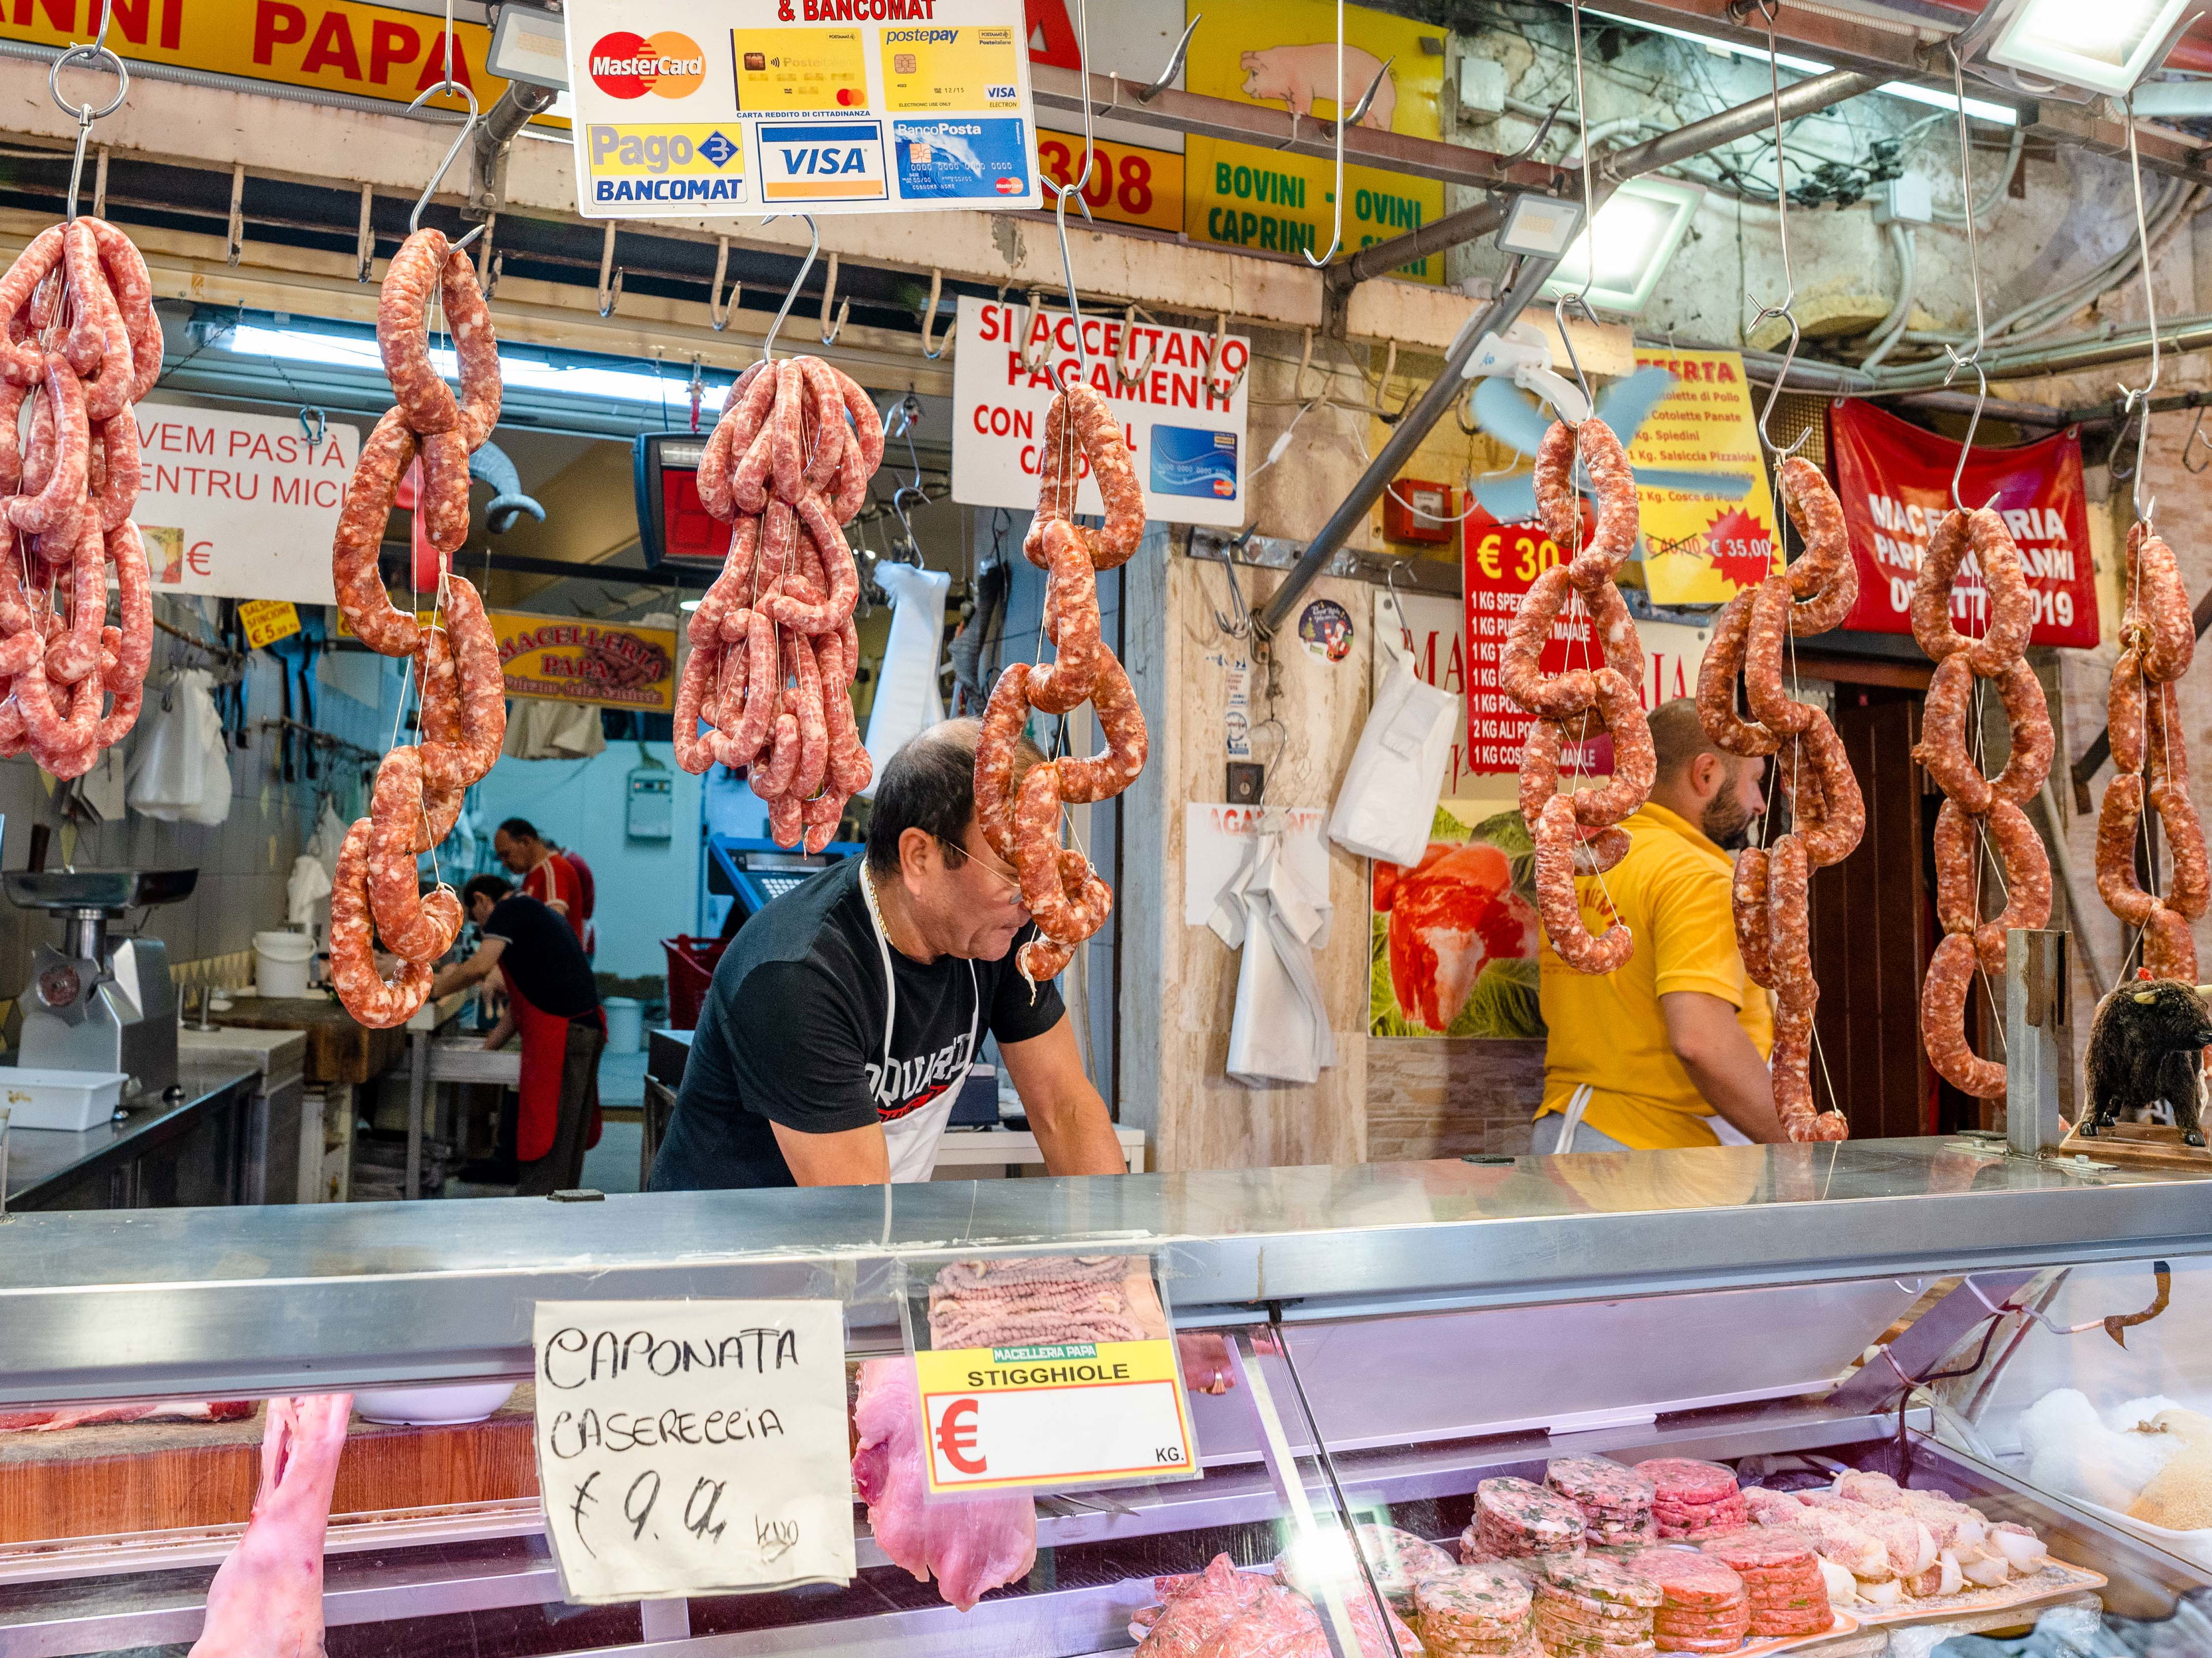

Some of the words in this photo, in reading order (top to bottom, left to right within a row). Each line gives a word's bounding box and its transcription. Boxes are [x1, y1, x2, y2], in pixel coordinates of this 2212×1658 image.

[803, 0, 936, 21] BANCOMAT
[887, 29, 959, 45] postepay
[0, 0, 180, 50] NNI
[252, 0, 476, 99] PAPA
[592, 55, 702, 76] MasterCard
[987, 87, 1016, 98] VISA
[897, 123, 982, 135] BancoPosta
[590, 126, 694, 173] Pago
[779, 147, 866, 175] VISA
[596, 179, 743, 202] BANCOMAT
[1216, 161, 1305, 209] BOVINI
[1355, 188, 1422, 230] OVINI
[1208, 207, 1316, 255] CAPRINI
[979, 305, 1012, 344] SI
[1028, 313, 1248, 374] ACCETTANO
[974, 404, 1033, 439] CON
[136, 421, 215, 456] VEM
[141, 462, 258, 501] ENTRU
[187, 541, 214, 575] €
[1477, 533, 1502, 579] €
[1725, 538, 1771, 559] 35,00
[1479, 591, 1495, 610] KG
[1480, 617, 1495, 635] KG
[1480, 643, 1496, 662] KG
[542, 655, 607, 678] PAPA
[1480, 669, 1497, 687] KG
[1481, 694, 1497, 713] KG
[1482, 720, 1497, 739] KG
[1499, 720, 1516, 740] ALI
[1482, 745, 1498, 765] KG
[544, 1326, 799, 1390] CAPONATA
[994, 1346, 1065, 1361] MACELLERIA
[1066, 1344, 1096, 1359] PAPA
[967, 1363, 1130, 1387] STIGGHIOLE
[551, 1407, 784, 1459] CASERECCIA
[935, 1398, 987, 1475] €
[1156, 1447, 1185, 1463] KG.
